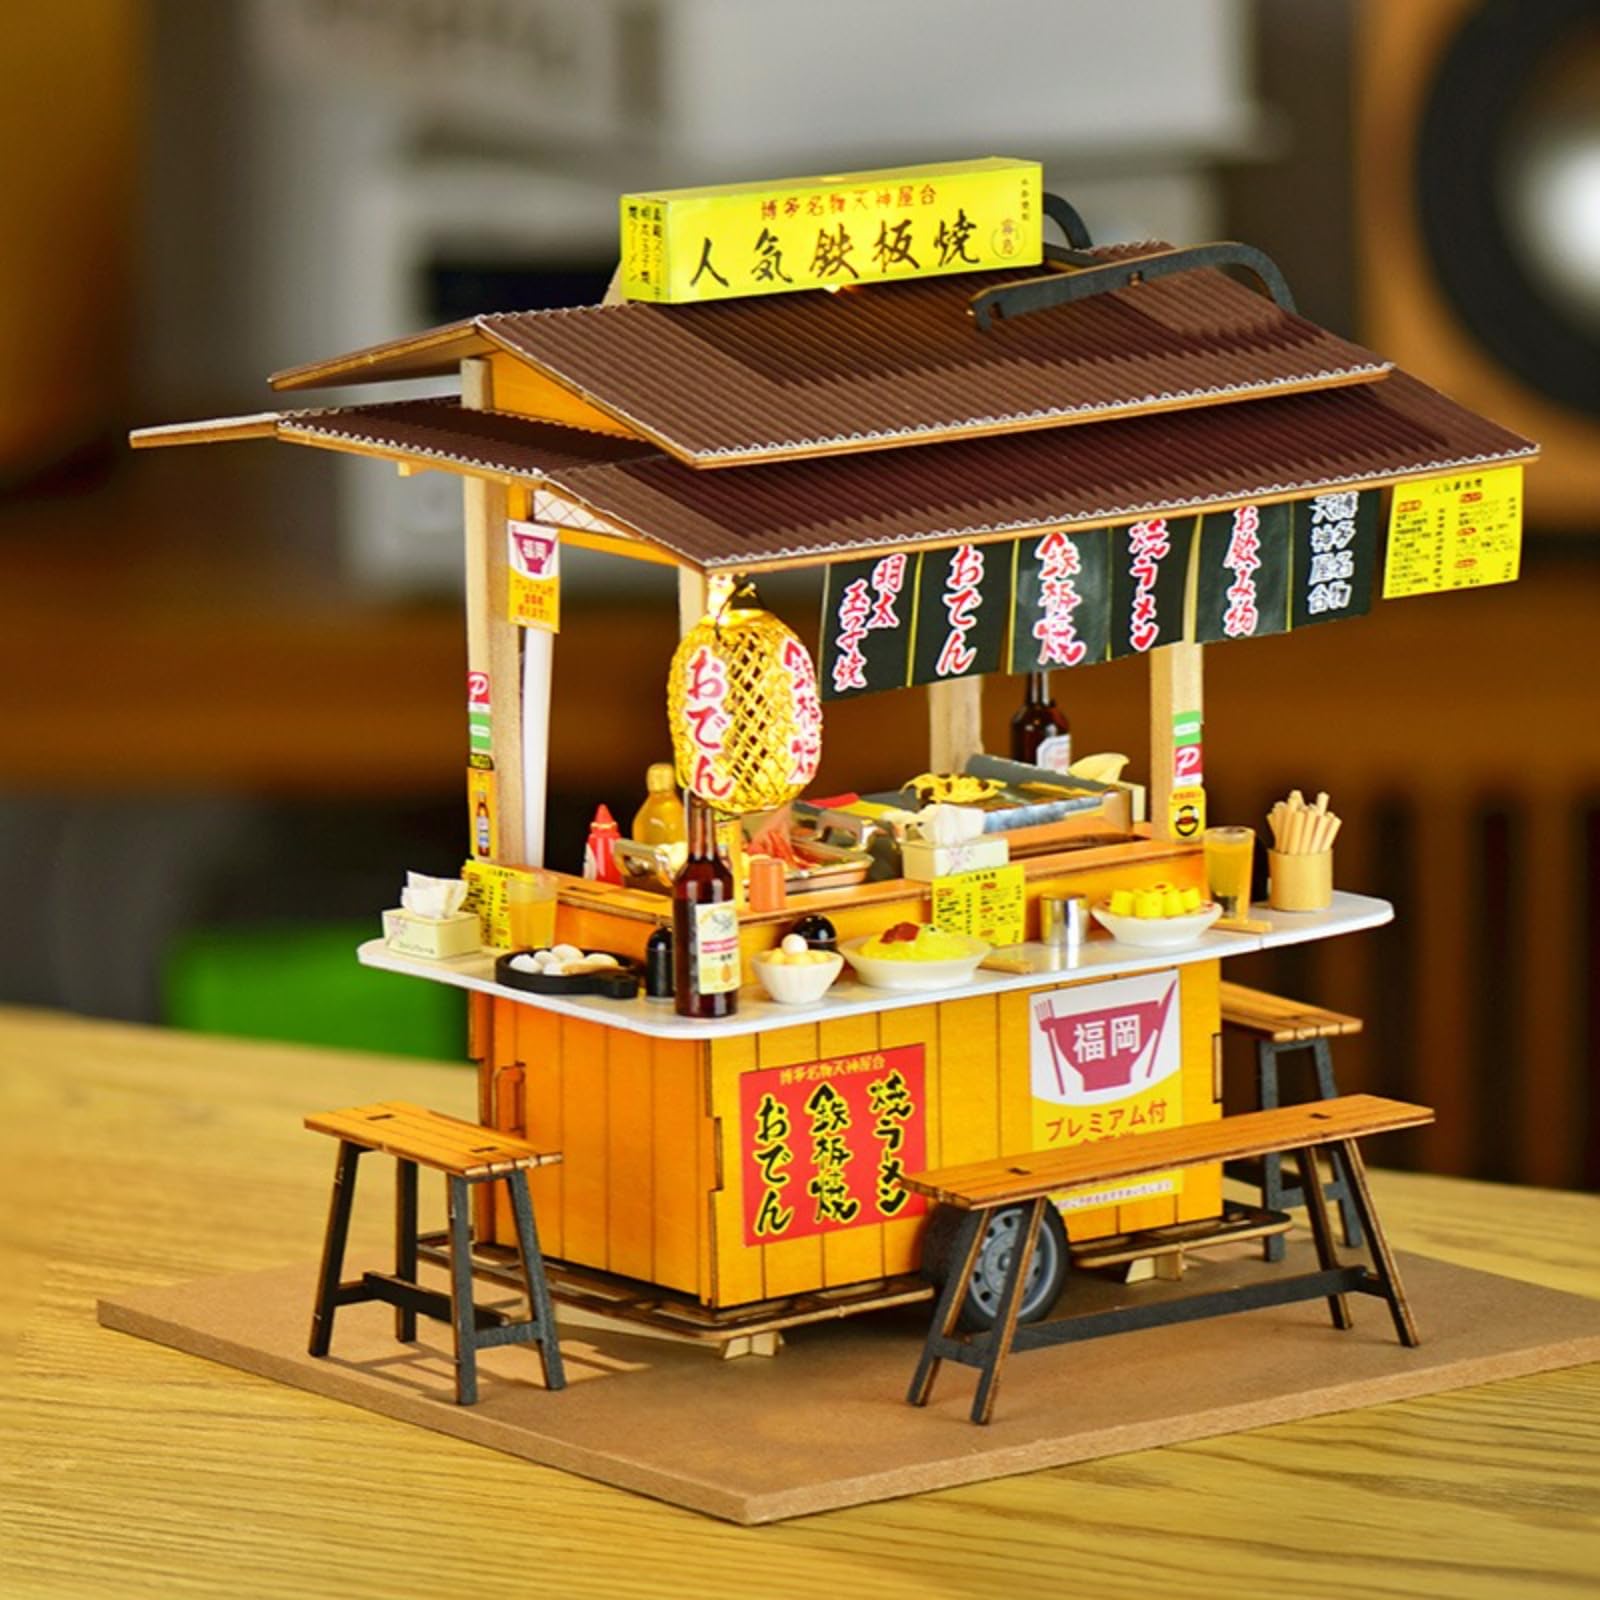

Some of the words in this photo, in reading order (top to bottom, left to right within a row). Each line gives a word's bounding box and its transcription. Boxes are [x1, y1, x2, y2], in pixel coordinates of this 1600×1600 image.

[690, 208, 981, 289] 人気鉄板焼
[761, 183, 938, 220] 博多名物天神屋台
[936, 544, 984, 676] おでん
[1033, 531, 1087, 666] 鉄板焼
[686, 647, 735, 798] おでん
[1072, 1013, 1140, 1064] 福岡
[753, 1092, 796, 1236] おでん
[804, 1081, 859, 1225] 鉄板焼
[868, 1068, 913, 1216] 焼ラーメン
[1045, 1099, 1168, 1143] プレミアム付
